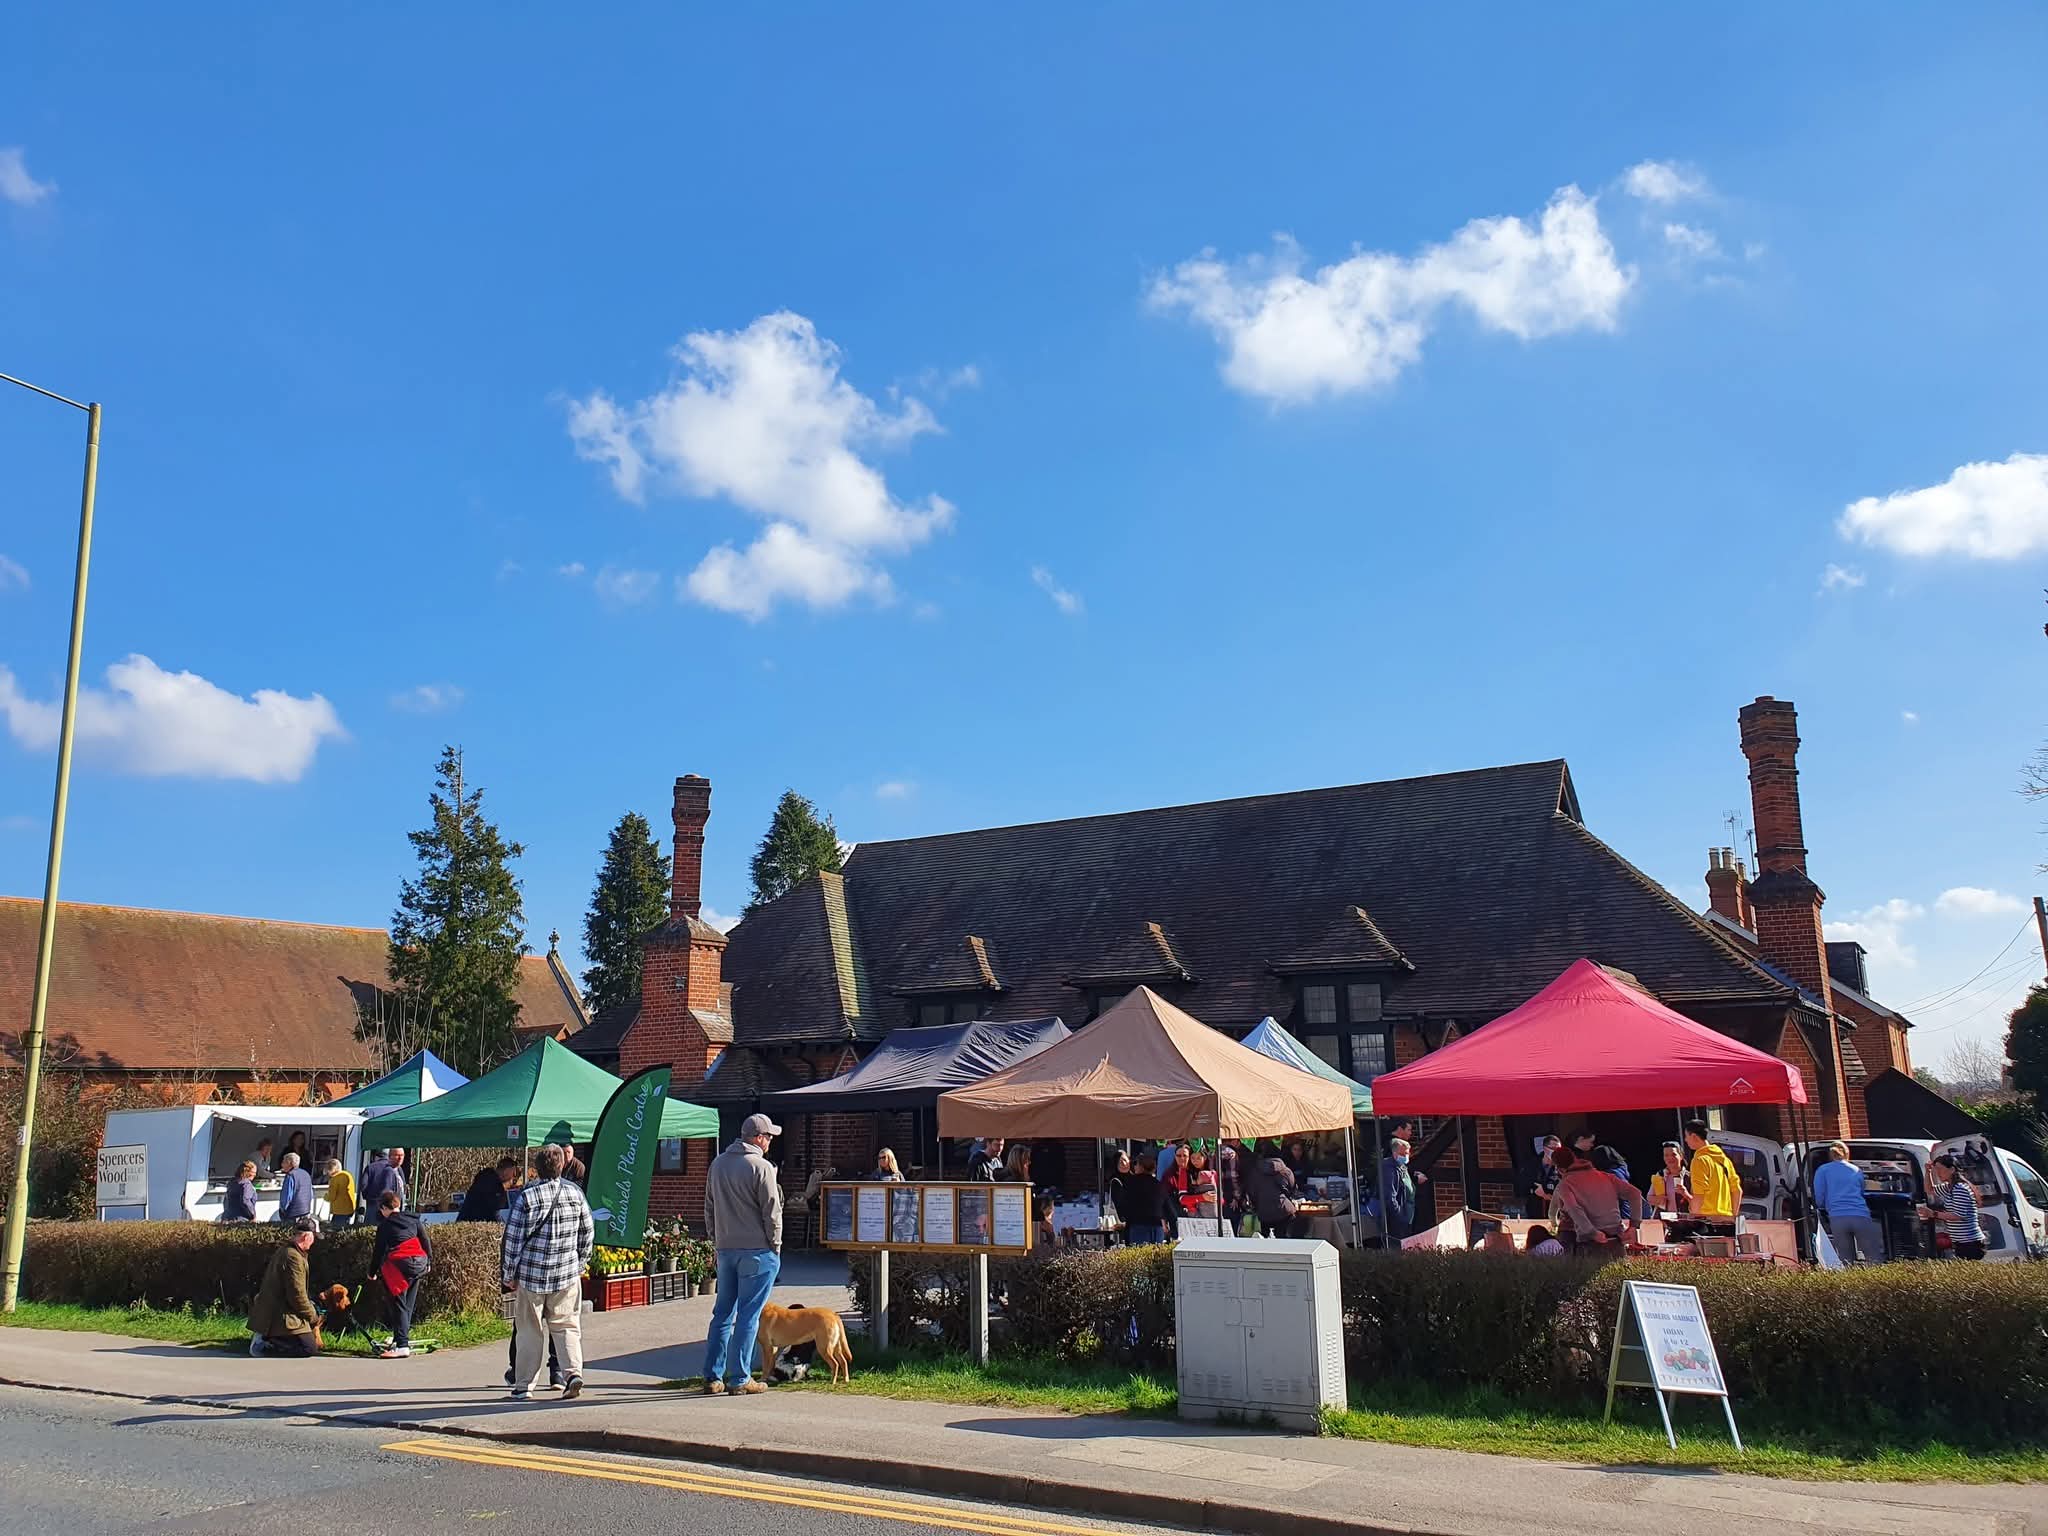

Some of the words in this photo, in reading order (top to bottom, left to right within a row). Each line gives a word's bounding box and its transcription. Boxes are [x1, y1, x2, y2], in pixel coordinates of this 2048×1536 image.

[626, 1084, 649, 1131] Centre
[98, 1152, 145, 1170] Spencers
[618, 1134, 639, 1175] Plant
[98, 1168, 127, 1184] Wood
[609, 1182, 632, 1237] Laurels
